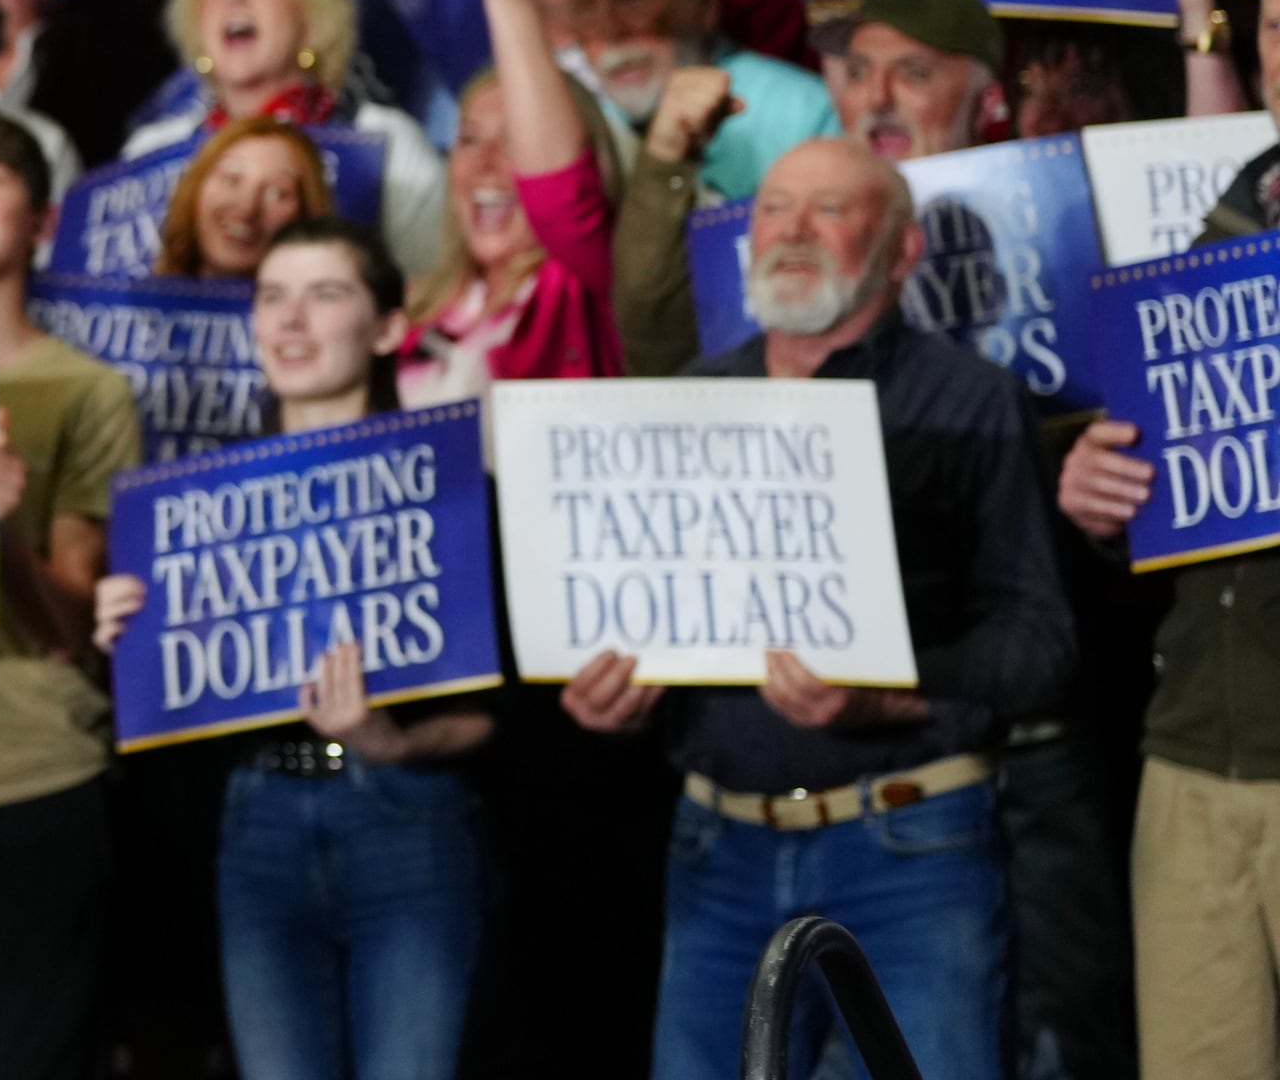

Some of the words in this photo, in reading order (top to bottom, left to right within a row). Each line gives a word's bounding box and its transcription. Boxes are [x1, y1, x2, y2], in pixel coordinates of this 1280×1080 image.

[1136, 275, 1280, 361] PROTE
[1147, 344, 1280, 441] TAXP
[548, 423, 835, 482] PROTECTING
[1163, 429, 1280, 530] DOL
[153, 444, 437, 554] PROTECTING
[551, 490, 846, 564] TAXPAYER
[152, 508, 441, 625] TAXPAYER
[563, 572, 857, 651] DOLLARS
